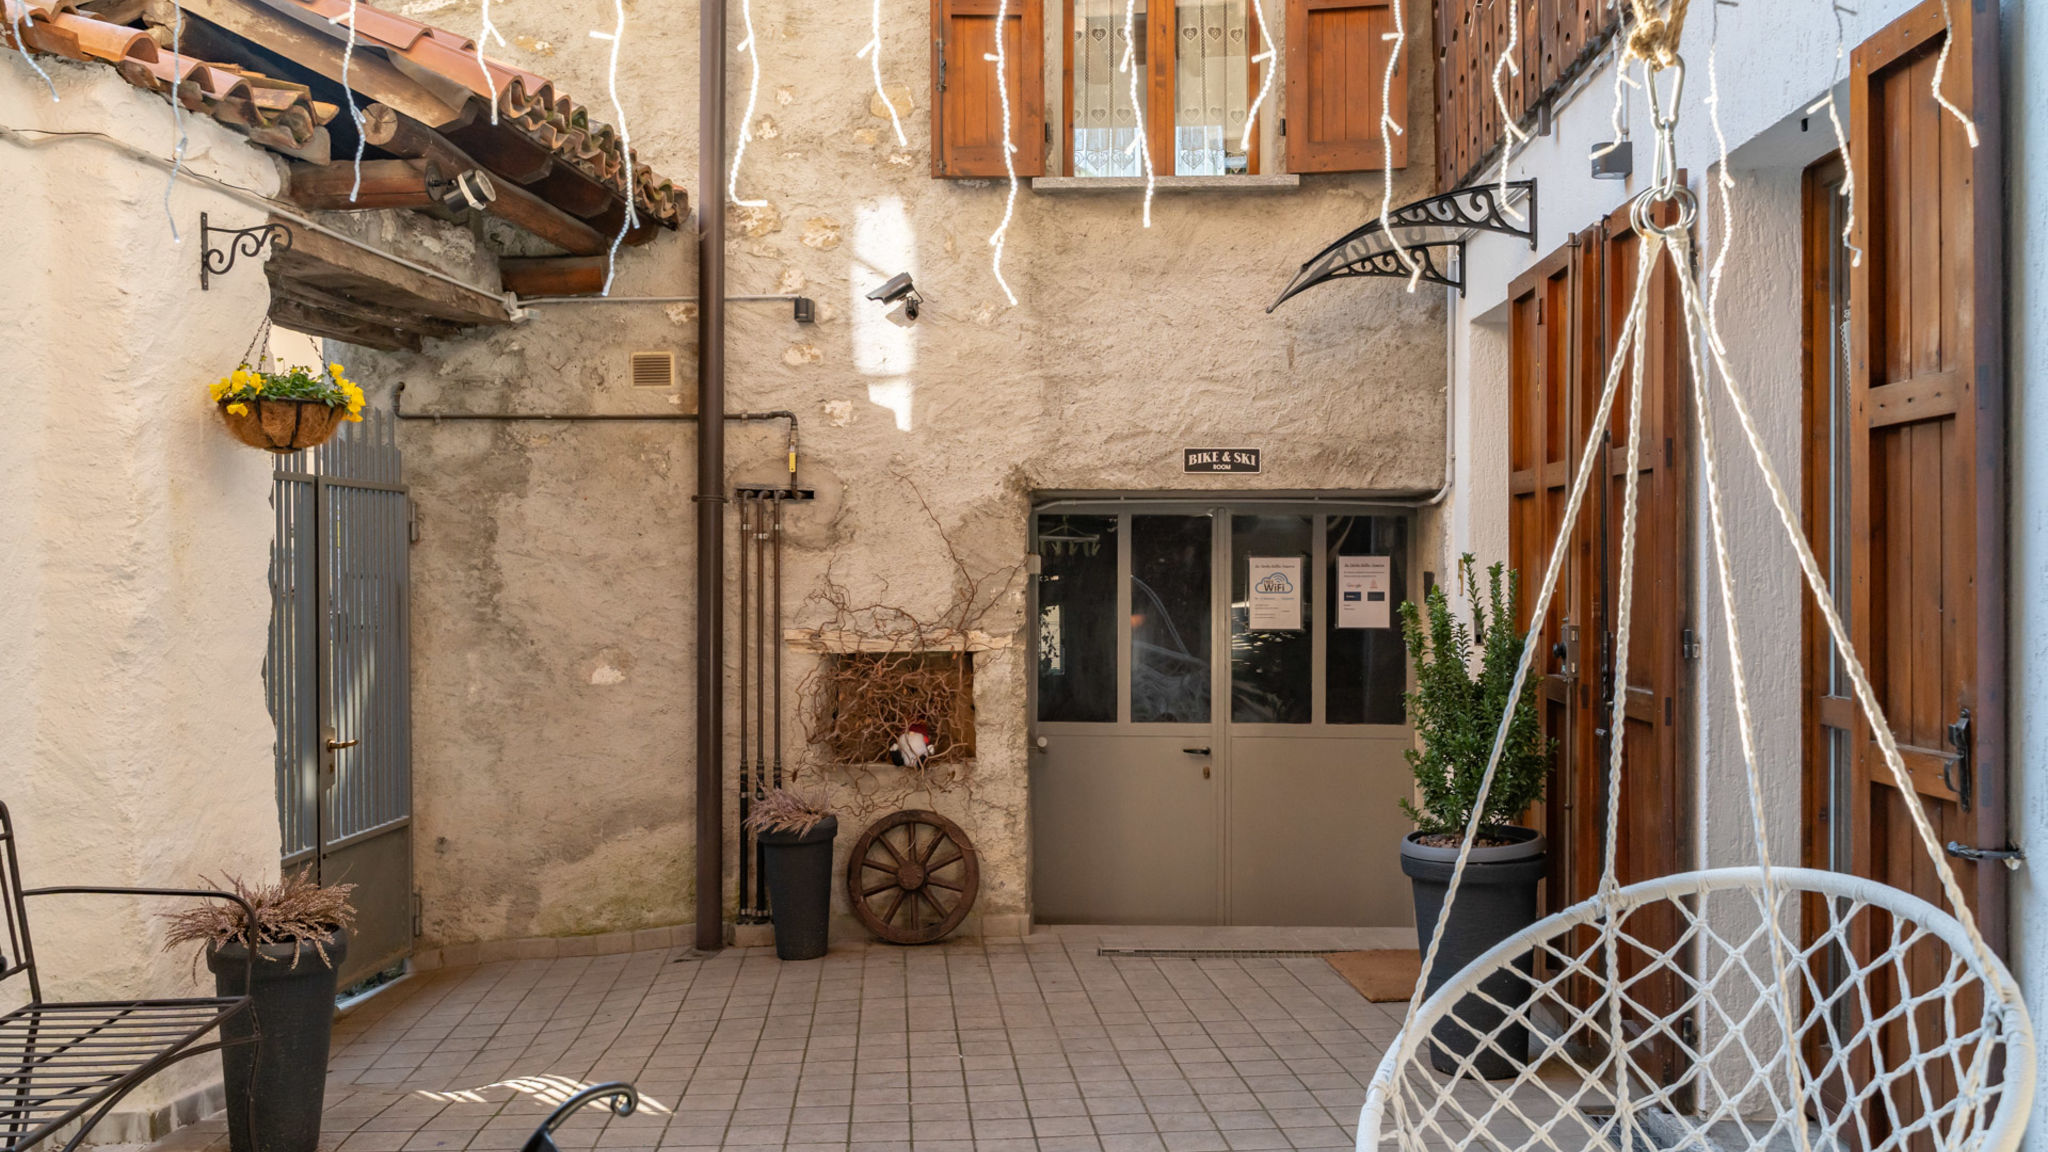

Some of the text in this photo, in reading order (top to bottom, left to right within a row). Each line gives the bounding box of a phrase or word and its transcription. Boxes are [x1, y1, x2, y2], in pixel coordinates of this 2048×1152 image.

[1188, 451, 1256, 466] BIKE & SKI
[1264, 583, 1285, 592] WiFi
